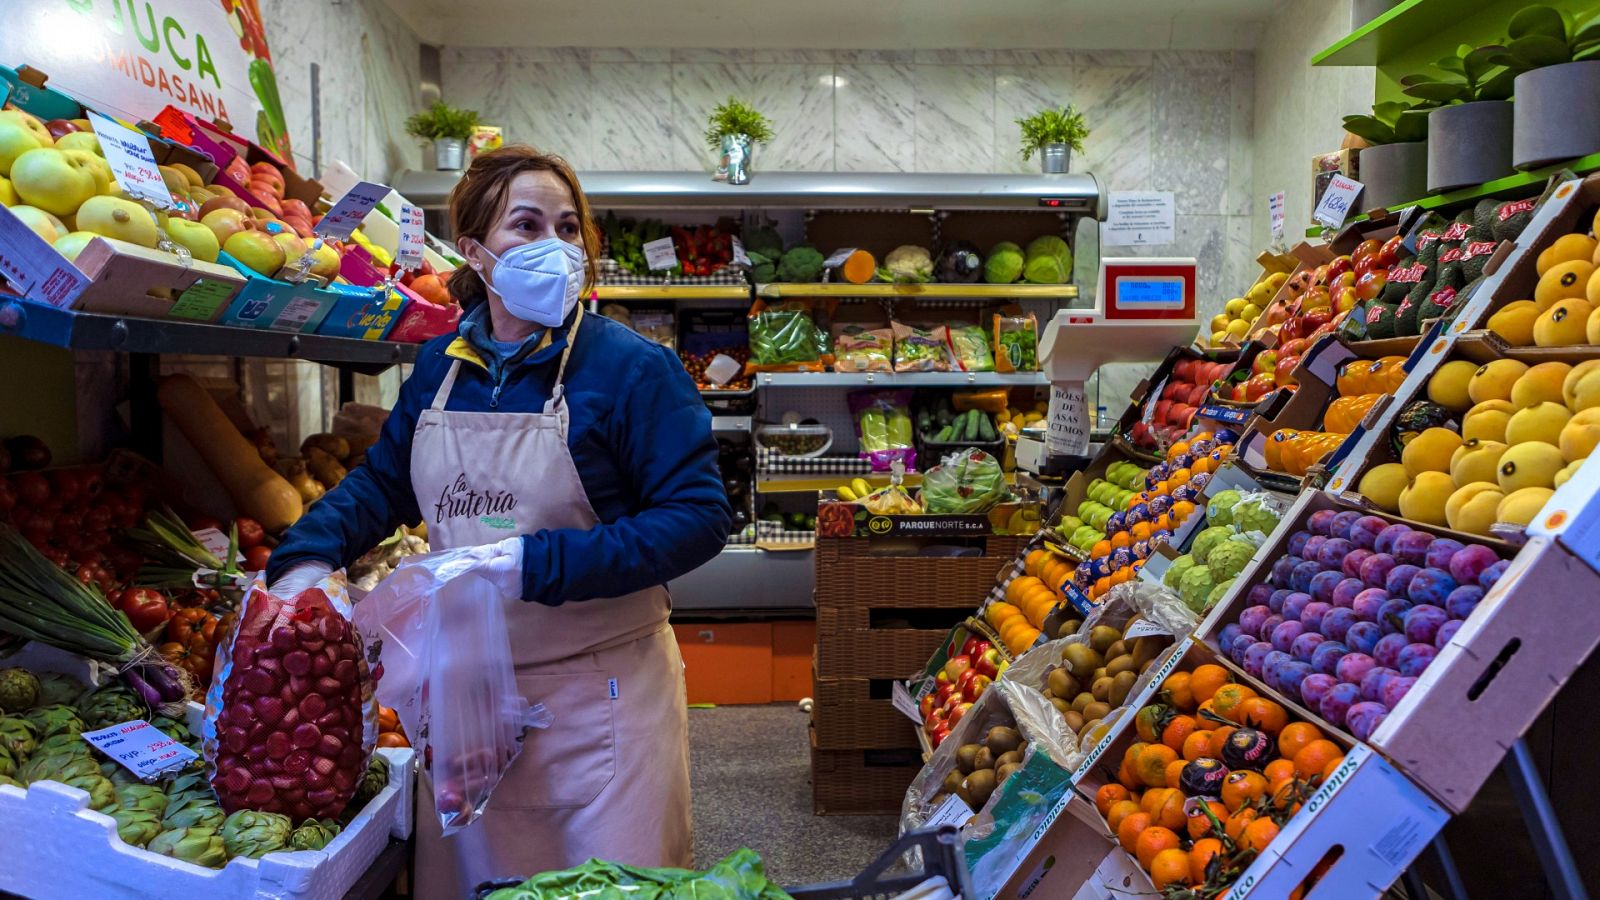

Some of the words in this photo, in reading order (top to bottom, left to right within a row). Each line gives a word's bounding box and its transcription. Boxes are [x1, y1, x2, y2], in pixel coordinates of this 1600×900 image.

[1054, 413, 1079, 423] ASAS
[1062, 403, 1076, 412] DE
[451, 472, 469, 495] la
[434, 485, 518, 524] frutería
[1308, 756, 1357, 812] Salaico
